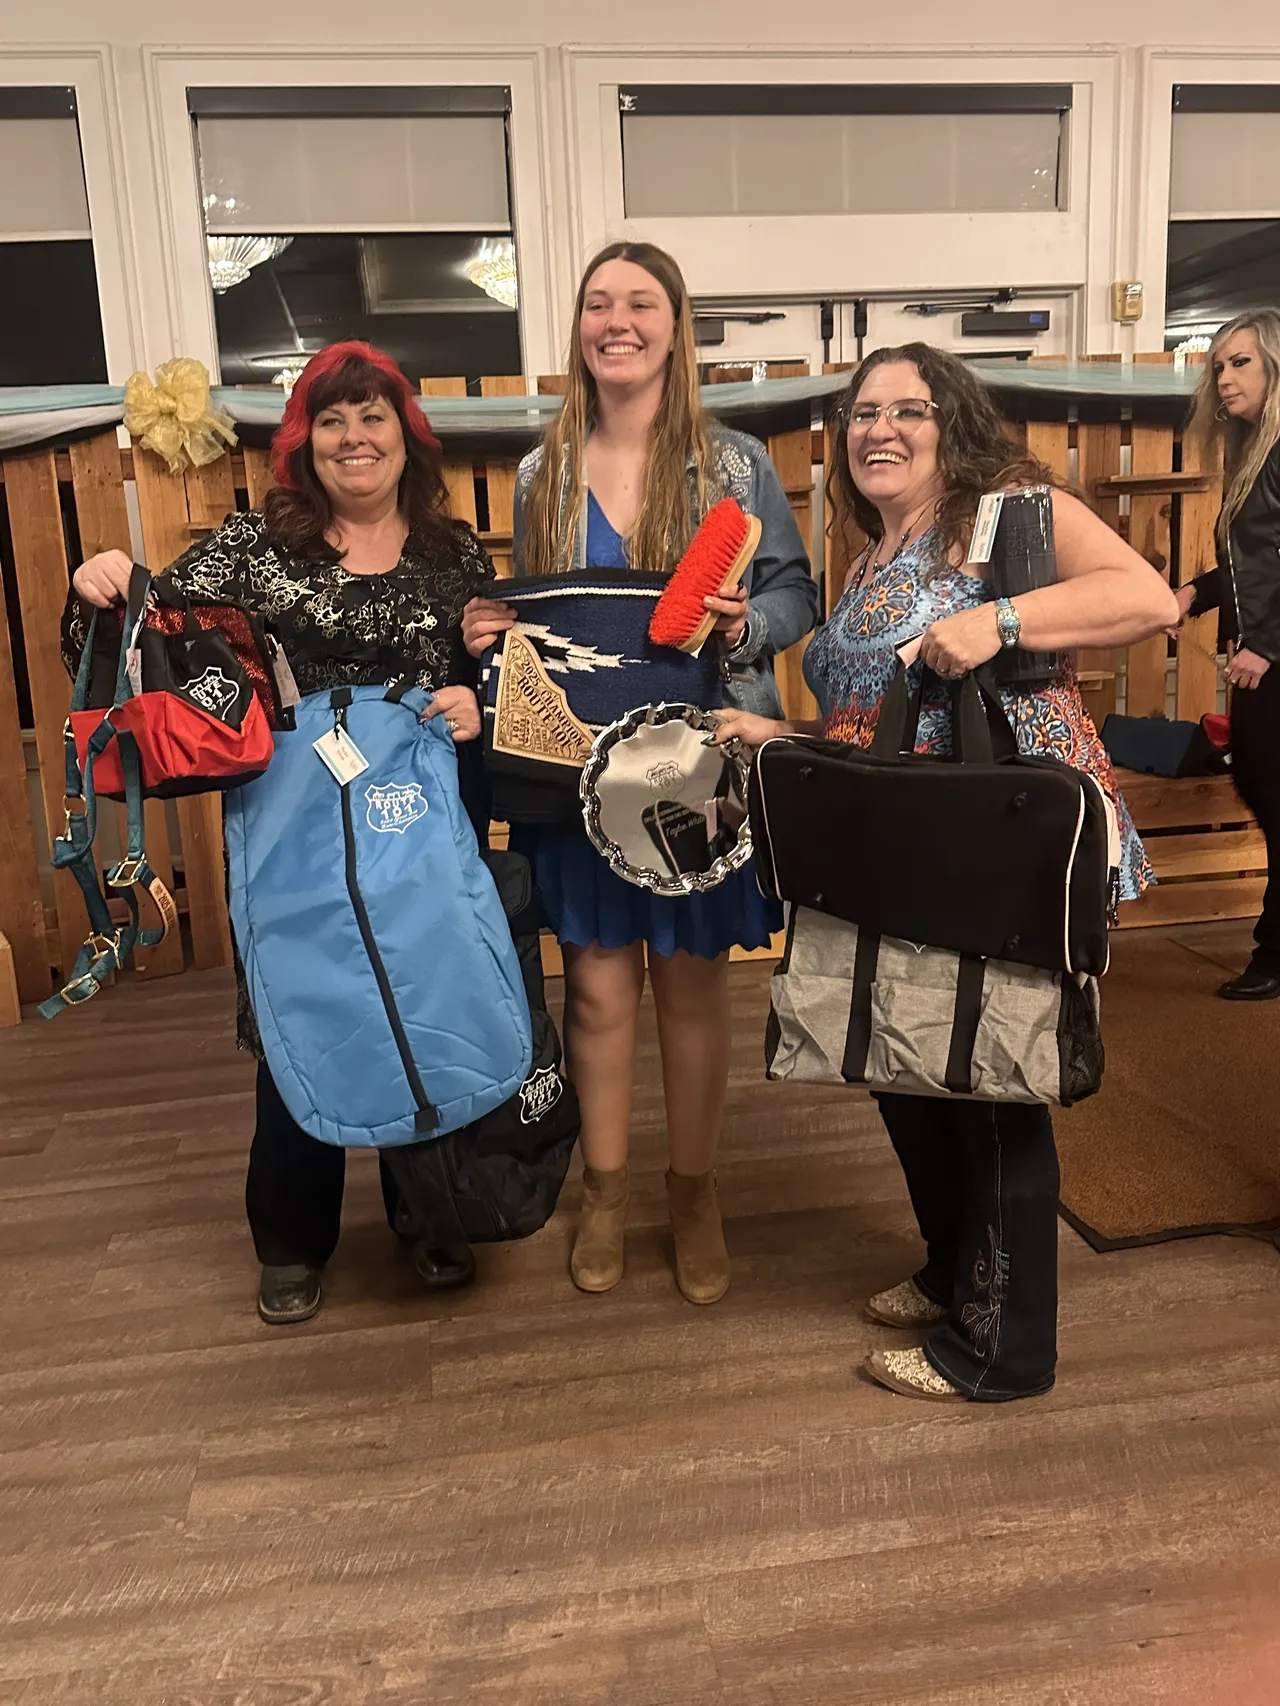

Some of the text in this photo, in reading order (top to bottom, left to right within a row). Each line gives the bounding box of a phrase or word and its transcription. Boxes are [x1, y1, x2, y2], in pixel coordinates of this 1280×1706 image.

[518, 676, 571, 748] ROUTE 101
[520, 661, 584, 747] 2025 CHAMPION
[375, 795, 415, 810] ROUTE
[381, 803, 412, 820] 101
[527, 1078, 556, 1104] ROUTE
[531, 1089, 552, 1110] 101
